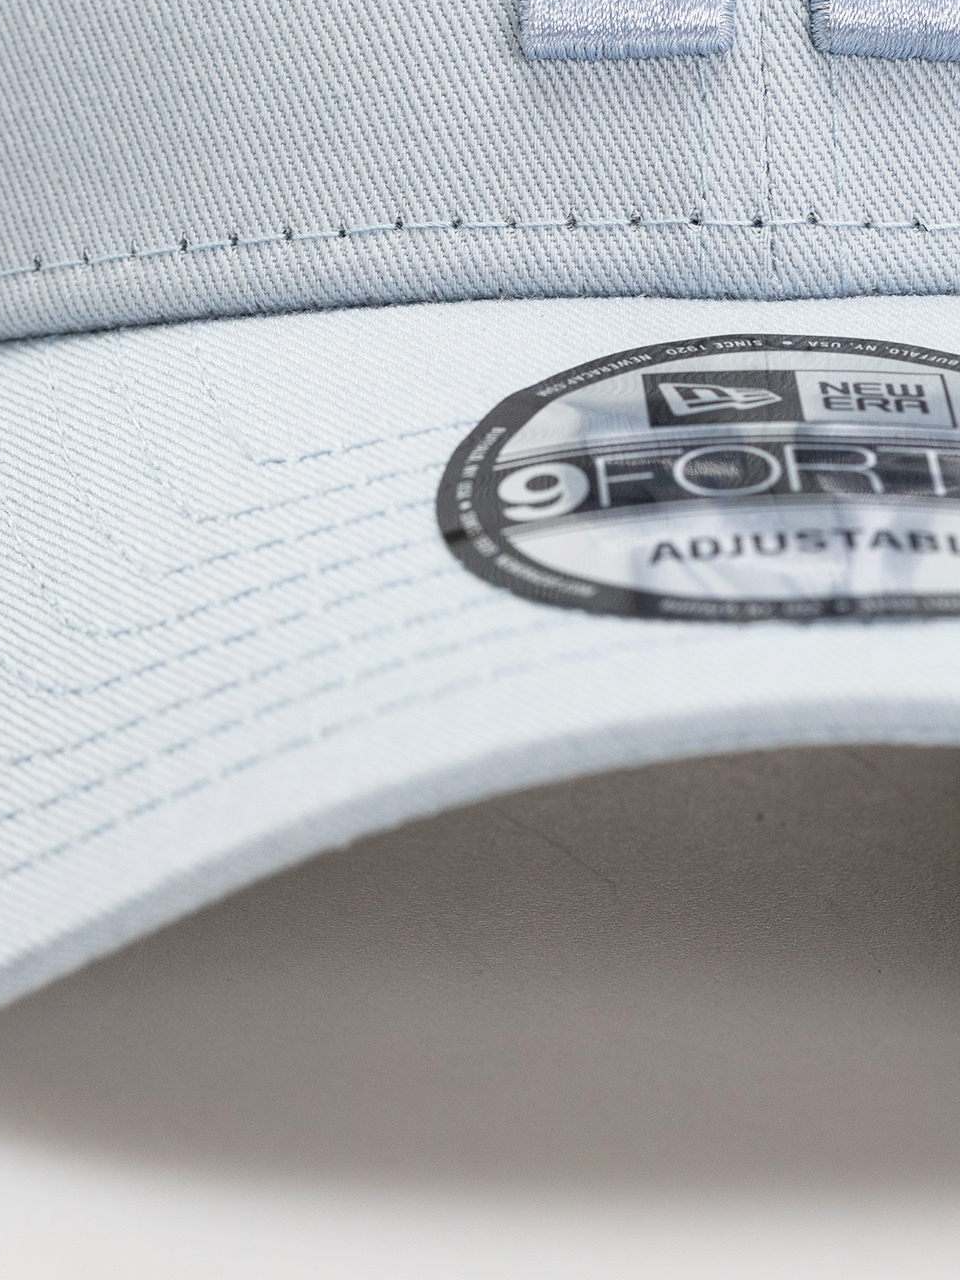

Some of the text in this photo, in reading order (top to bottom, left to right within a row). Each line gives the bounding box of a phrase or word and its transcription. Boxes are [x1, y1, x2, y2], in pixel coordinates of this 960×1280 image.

[665, 344, 706, 355] 1920
[713, 339, 763, 350] SINCE
[818, 380, 926, 398] NEW
[823, 395, 931, 415] ERA
